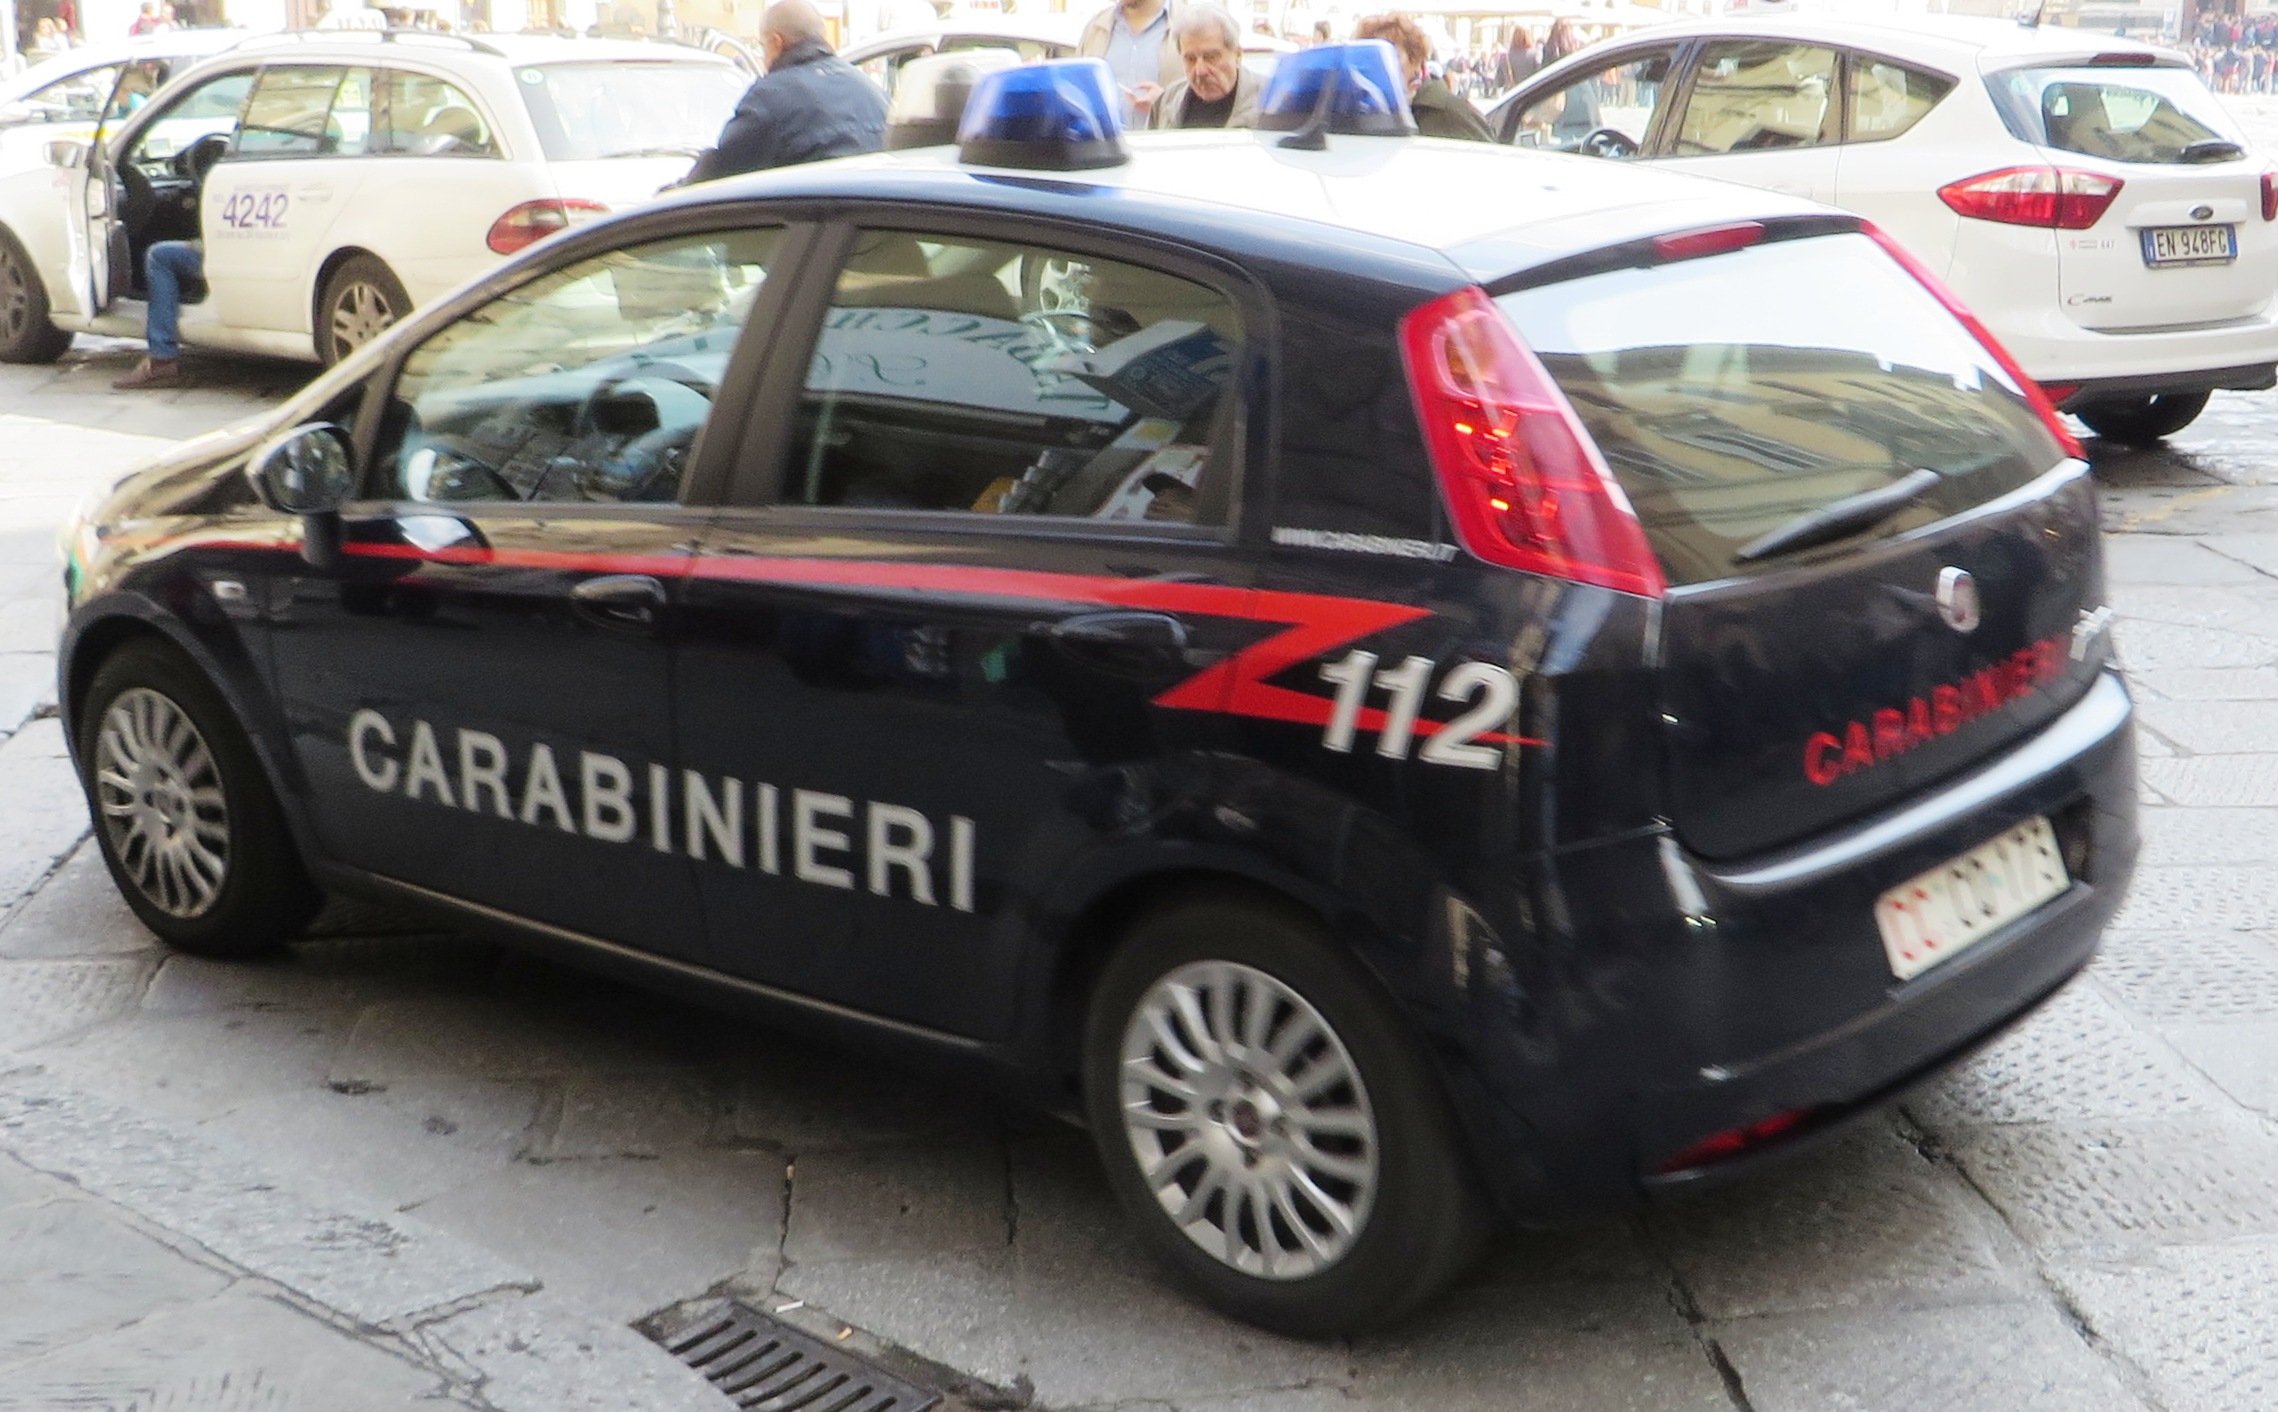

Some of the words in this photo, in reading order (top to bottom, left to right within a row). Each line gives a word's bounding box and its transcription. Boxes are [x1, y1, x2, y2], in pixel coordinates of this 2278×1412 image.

[222, 193, 290, 229] 4242
[2155, 230, 2177, 257] EN
[1318, 648, 1520, 771] 112
[348, 708, 975, 913] CARABINIERI
